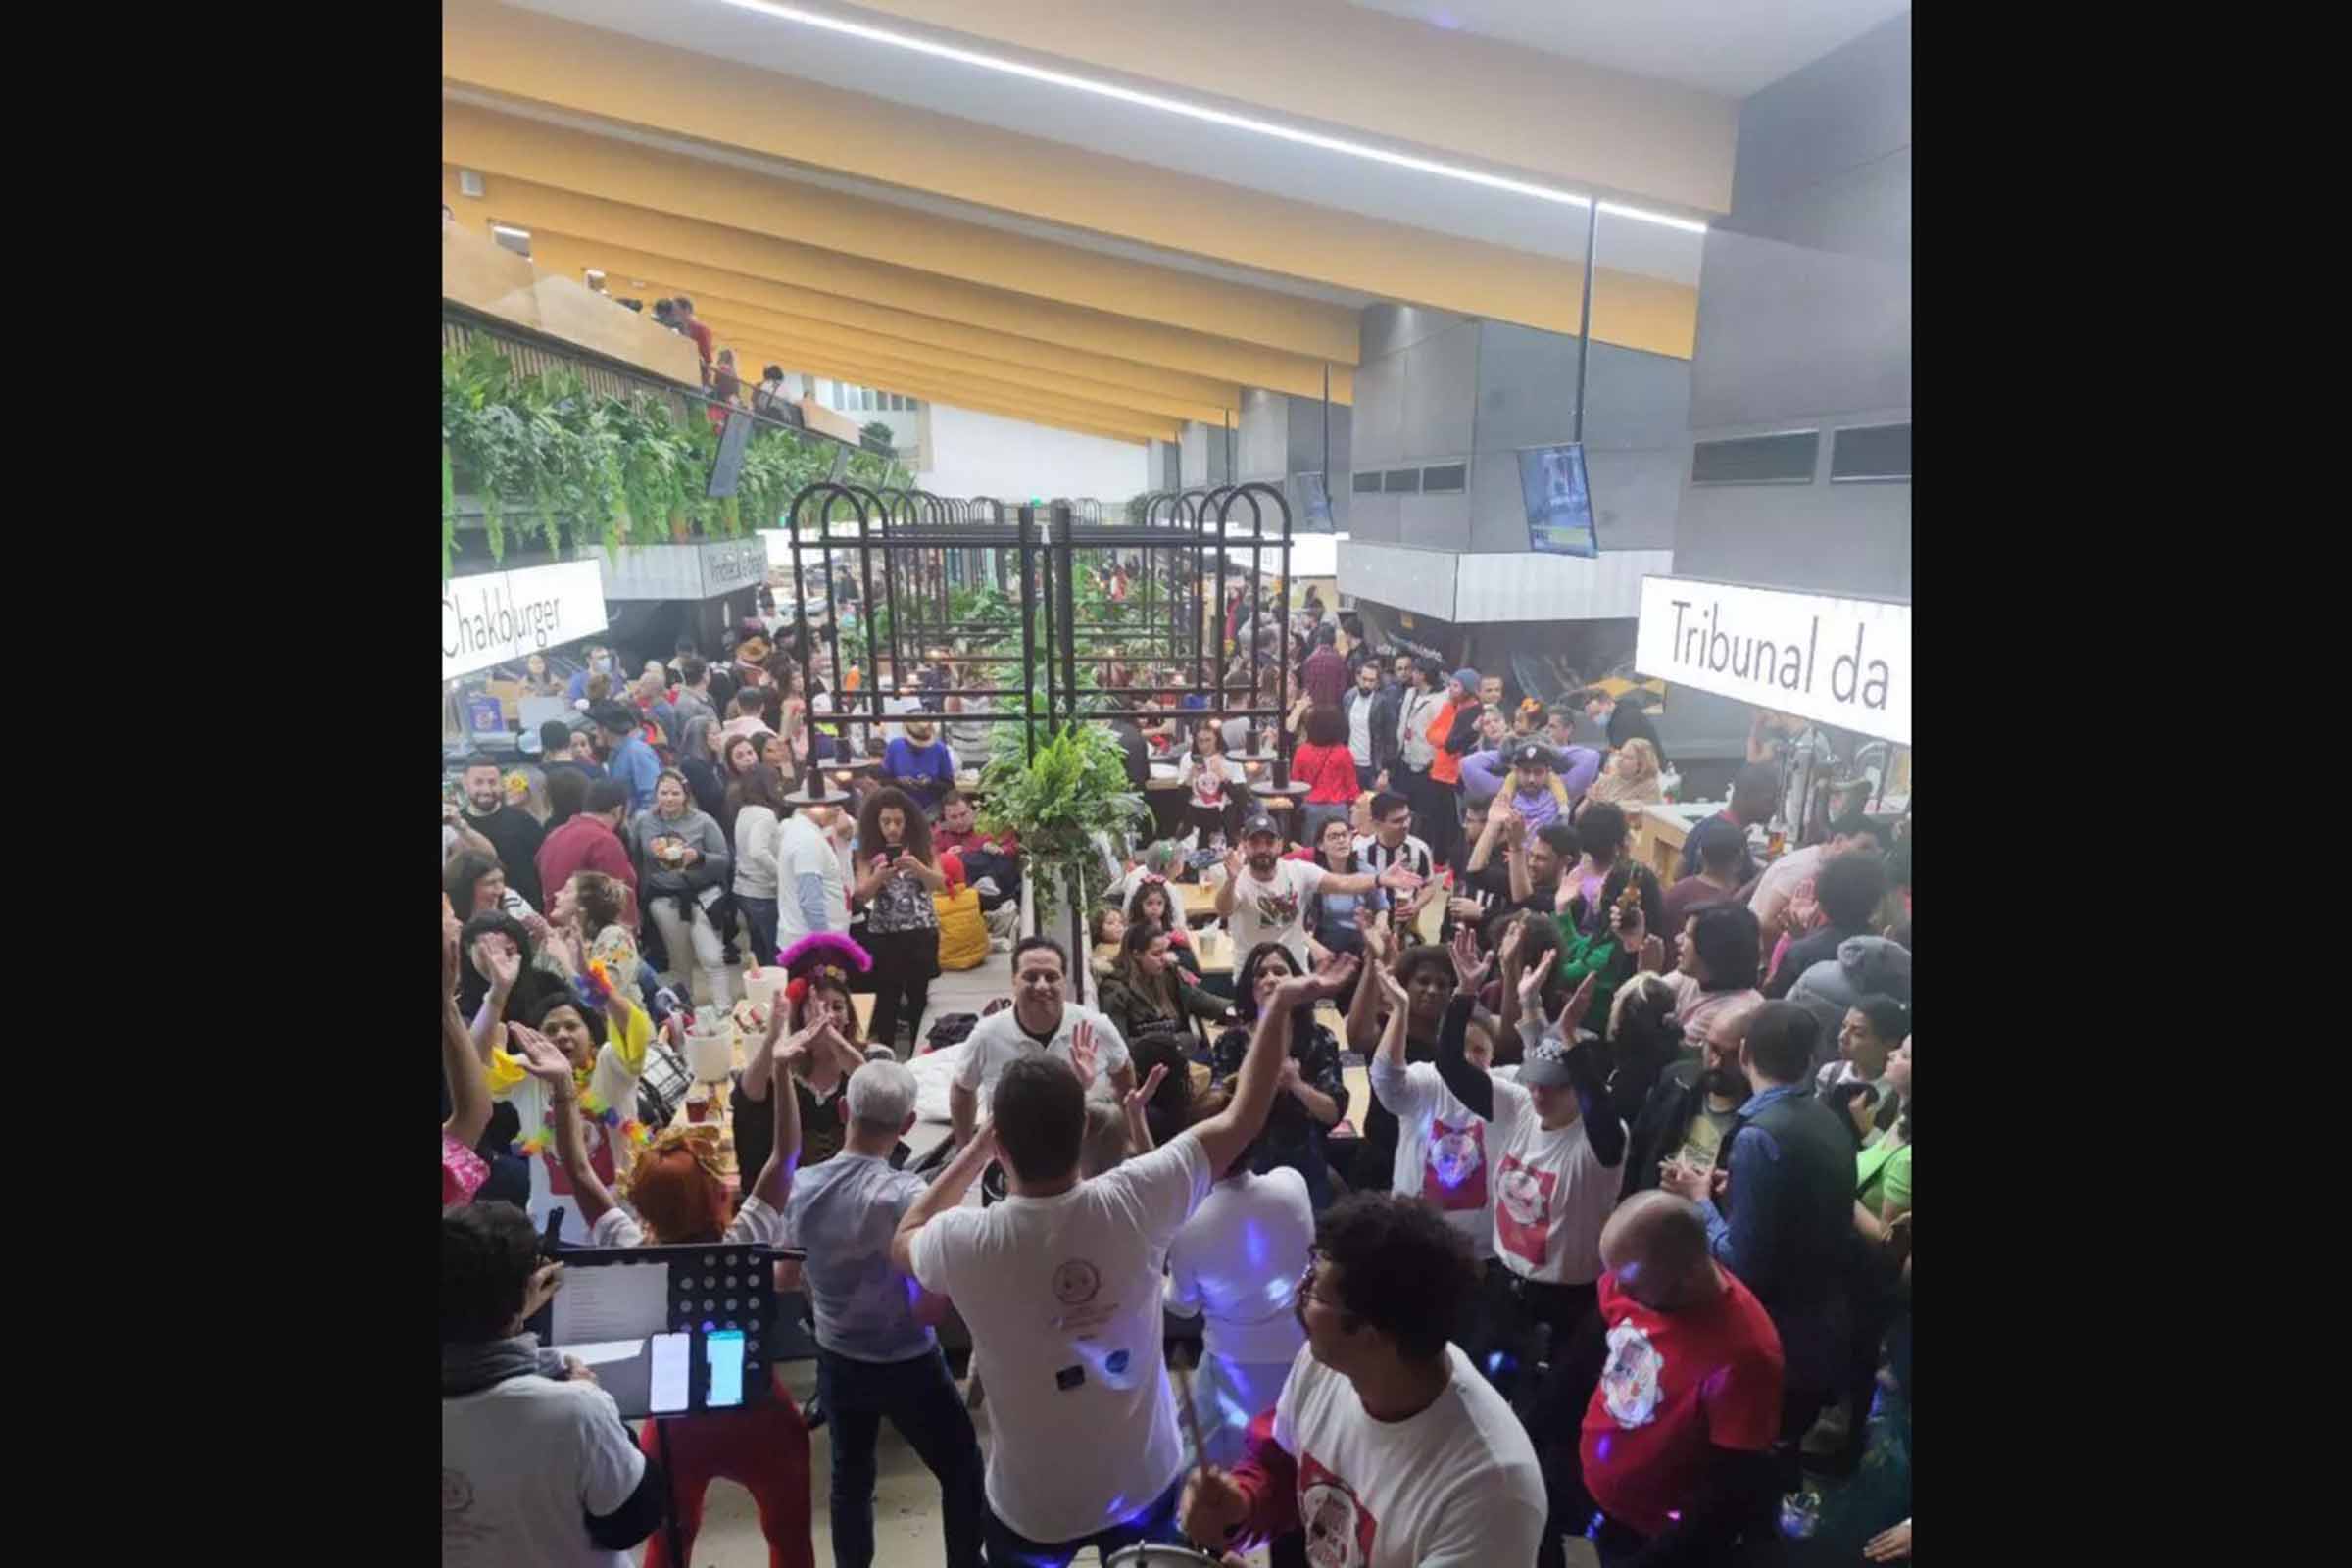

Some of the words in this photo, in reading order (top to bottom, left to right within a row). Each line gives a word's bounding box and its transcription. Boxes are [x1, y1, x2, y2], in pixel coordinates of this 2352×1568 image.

[442, 587, 560, 658] Chakburger
[1671, 600, 1819, 694] Tribunal
[1831, 621, 1889, 710] da
